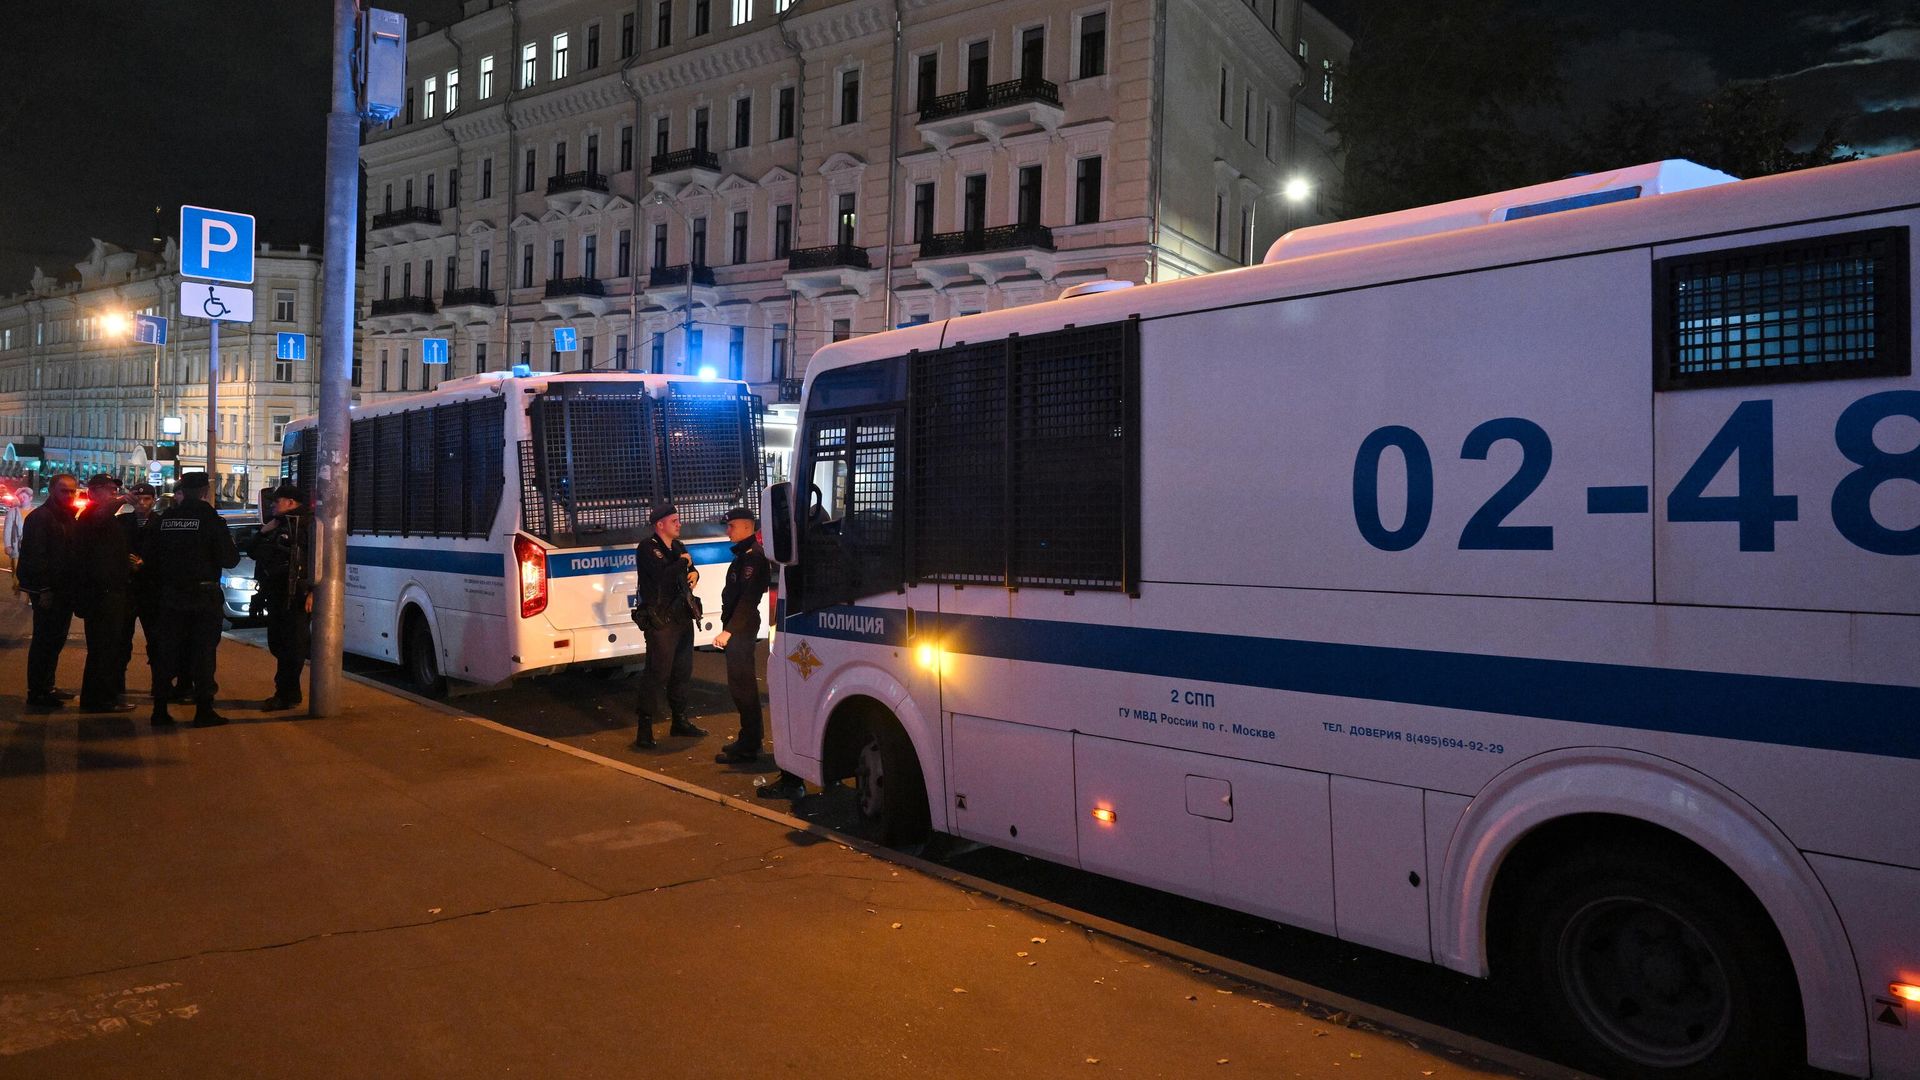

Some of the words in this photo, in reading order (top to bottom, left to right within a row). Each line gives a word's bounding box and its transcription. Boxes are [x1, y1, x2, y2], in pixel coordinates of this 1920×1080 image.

[201, 218, 238, 269] P
[1353, 390, 1920, 556] 02-48
[162, 520, 197, 528] ПОЛИЦИЯ
[571, 554, 637, 571] ПОЛИЦИЯ
[818, 612, 885, 635] ПОЛИЦИЯ
[1171, 689, 1179, 703] 2
[1185, 691, 1215, 708] СПП
[1119, 707, 1130, 718] ГУ
[1133, 709, 1157, 723] МВД
[1160, 713, 1199, 728] России
[1202, 721, 1215, 731] по
[1219, 724, 1228, 733] г.
[1232, 724, 1276, 740] Москве
[1322, 722, 1346, 734] ТЕЛ.
[1349, 725, 1401, 742] ДОВЕРИЯ
[1405, 732, 1505, 754] 8(495)694-92-29
